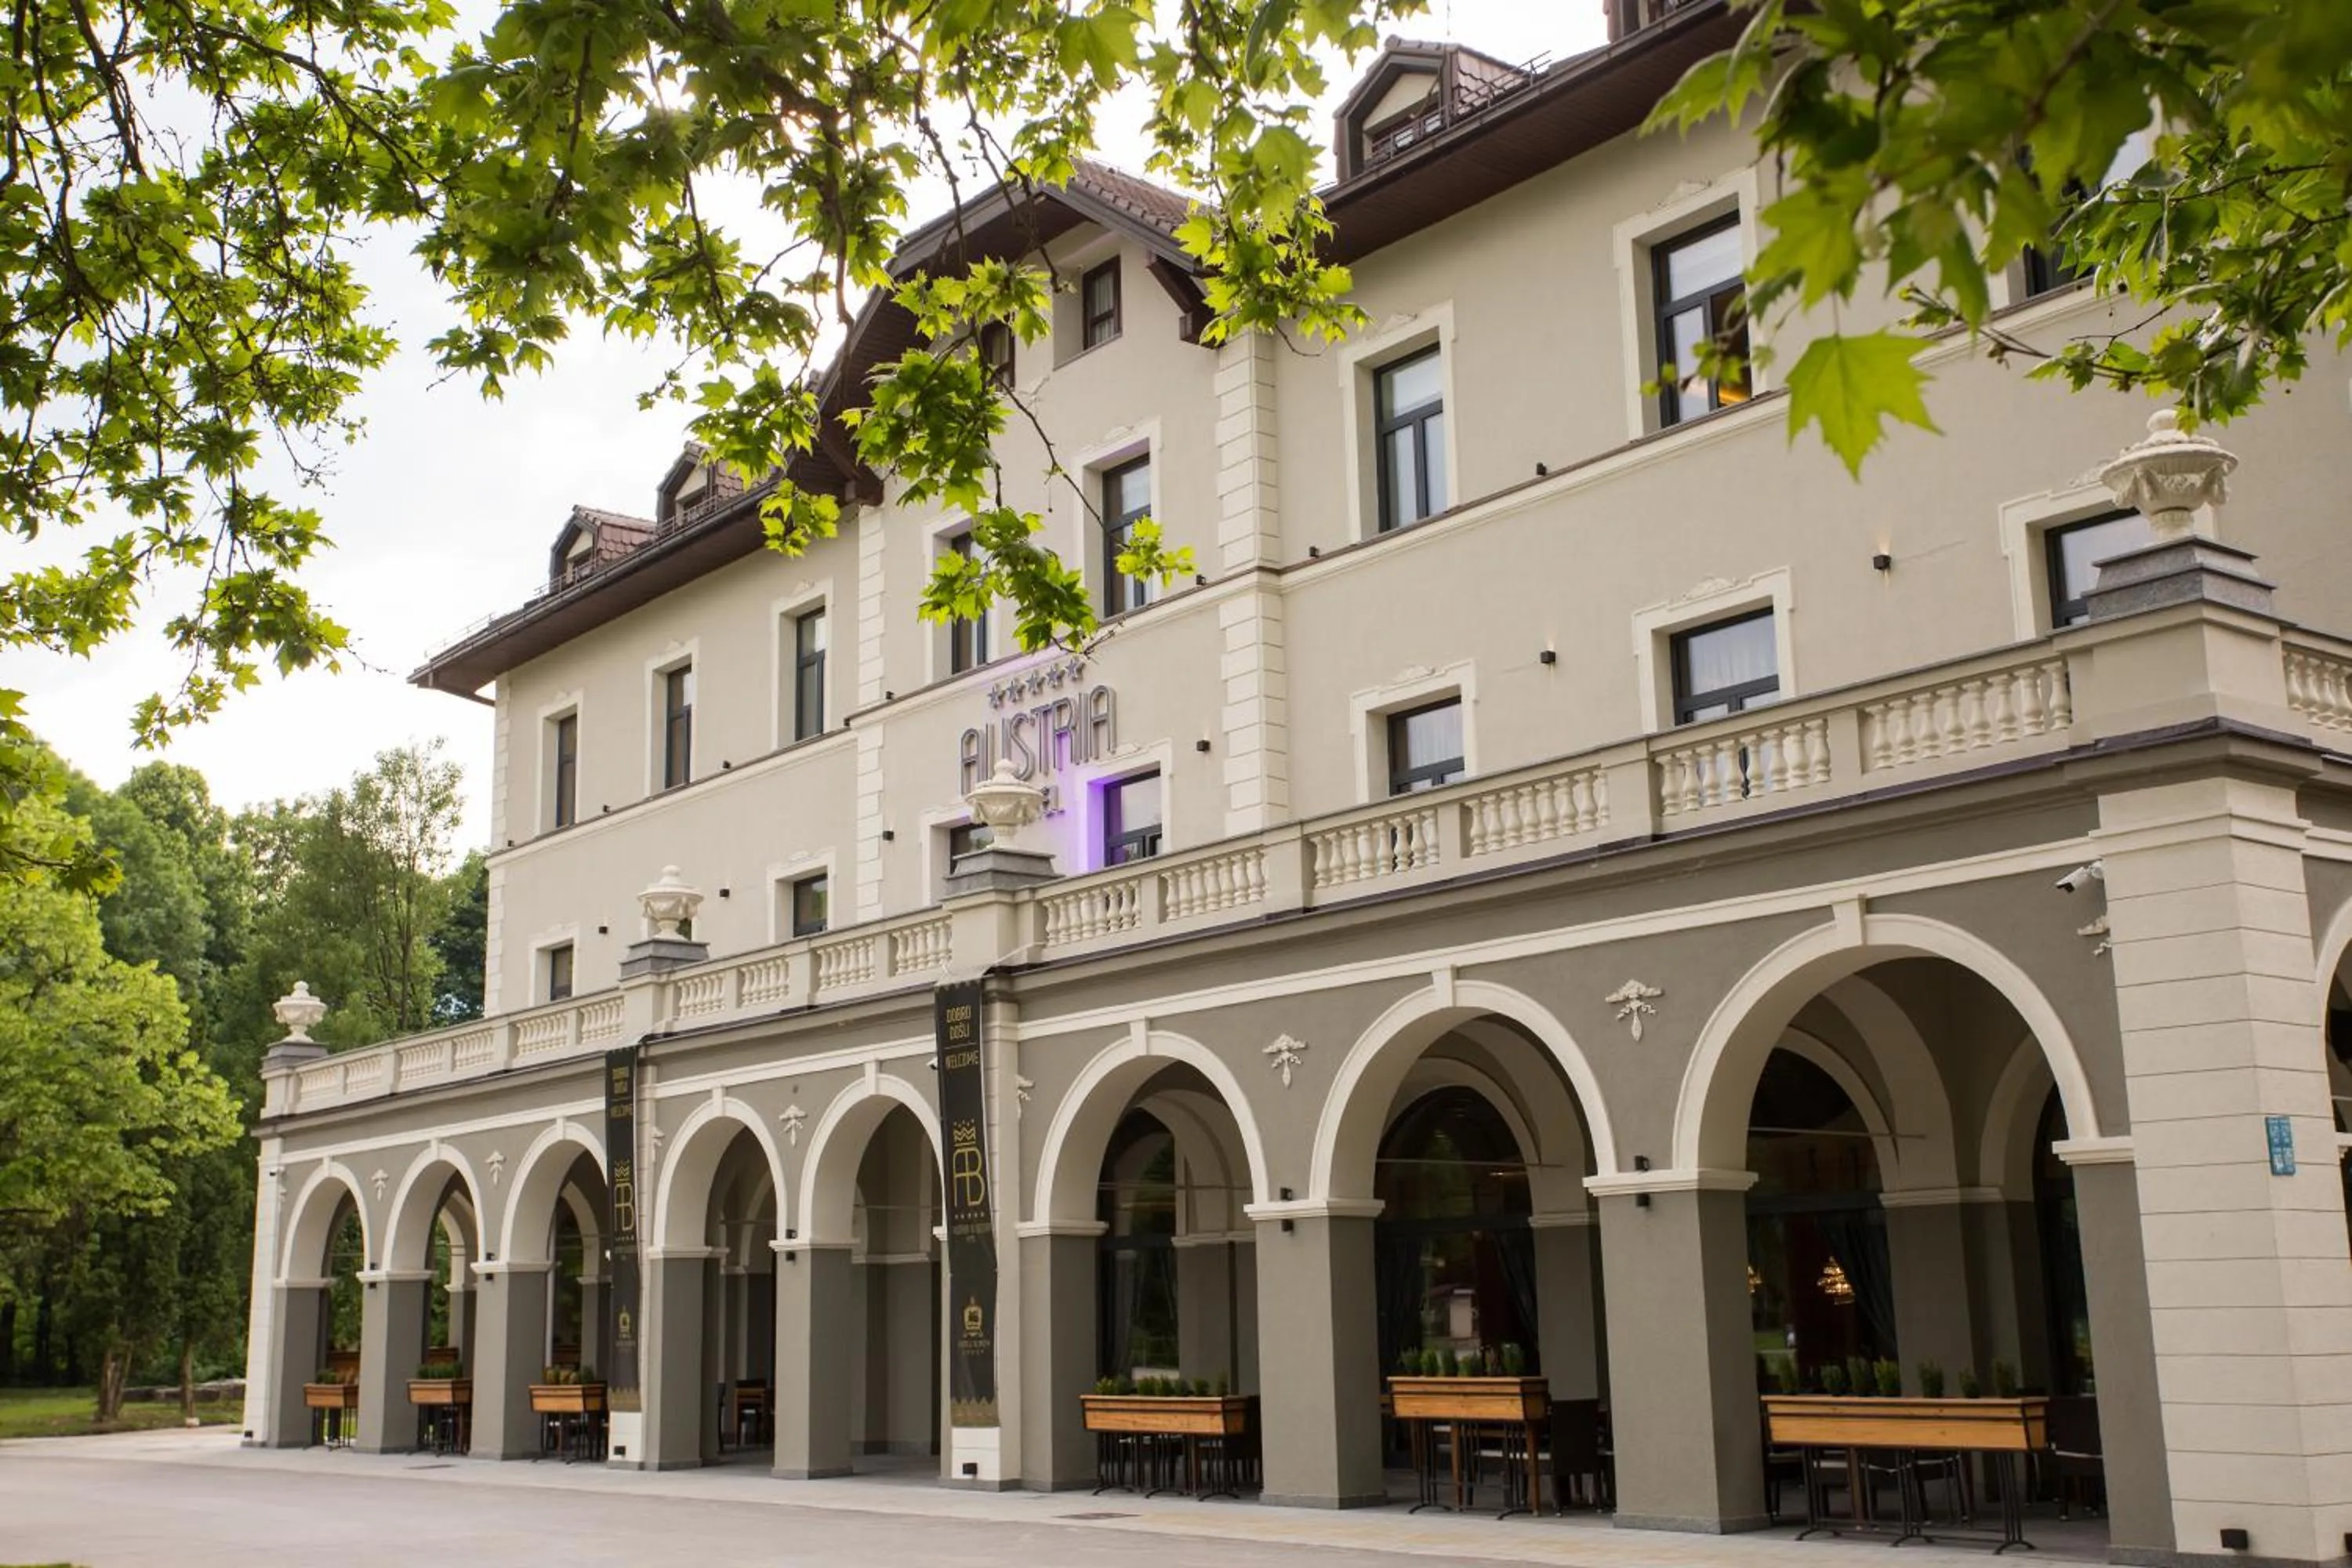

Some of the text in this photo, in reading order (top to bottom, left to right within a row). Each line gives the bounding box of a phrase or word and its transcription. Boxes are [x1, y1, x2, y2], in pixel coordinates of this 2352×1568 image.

[960, 684, 1116, 796] AUSTRIA
[946, 1004, 971, 1023] DOBRO
[946, 1050, 979, 1069] WELCOME
